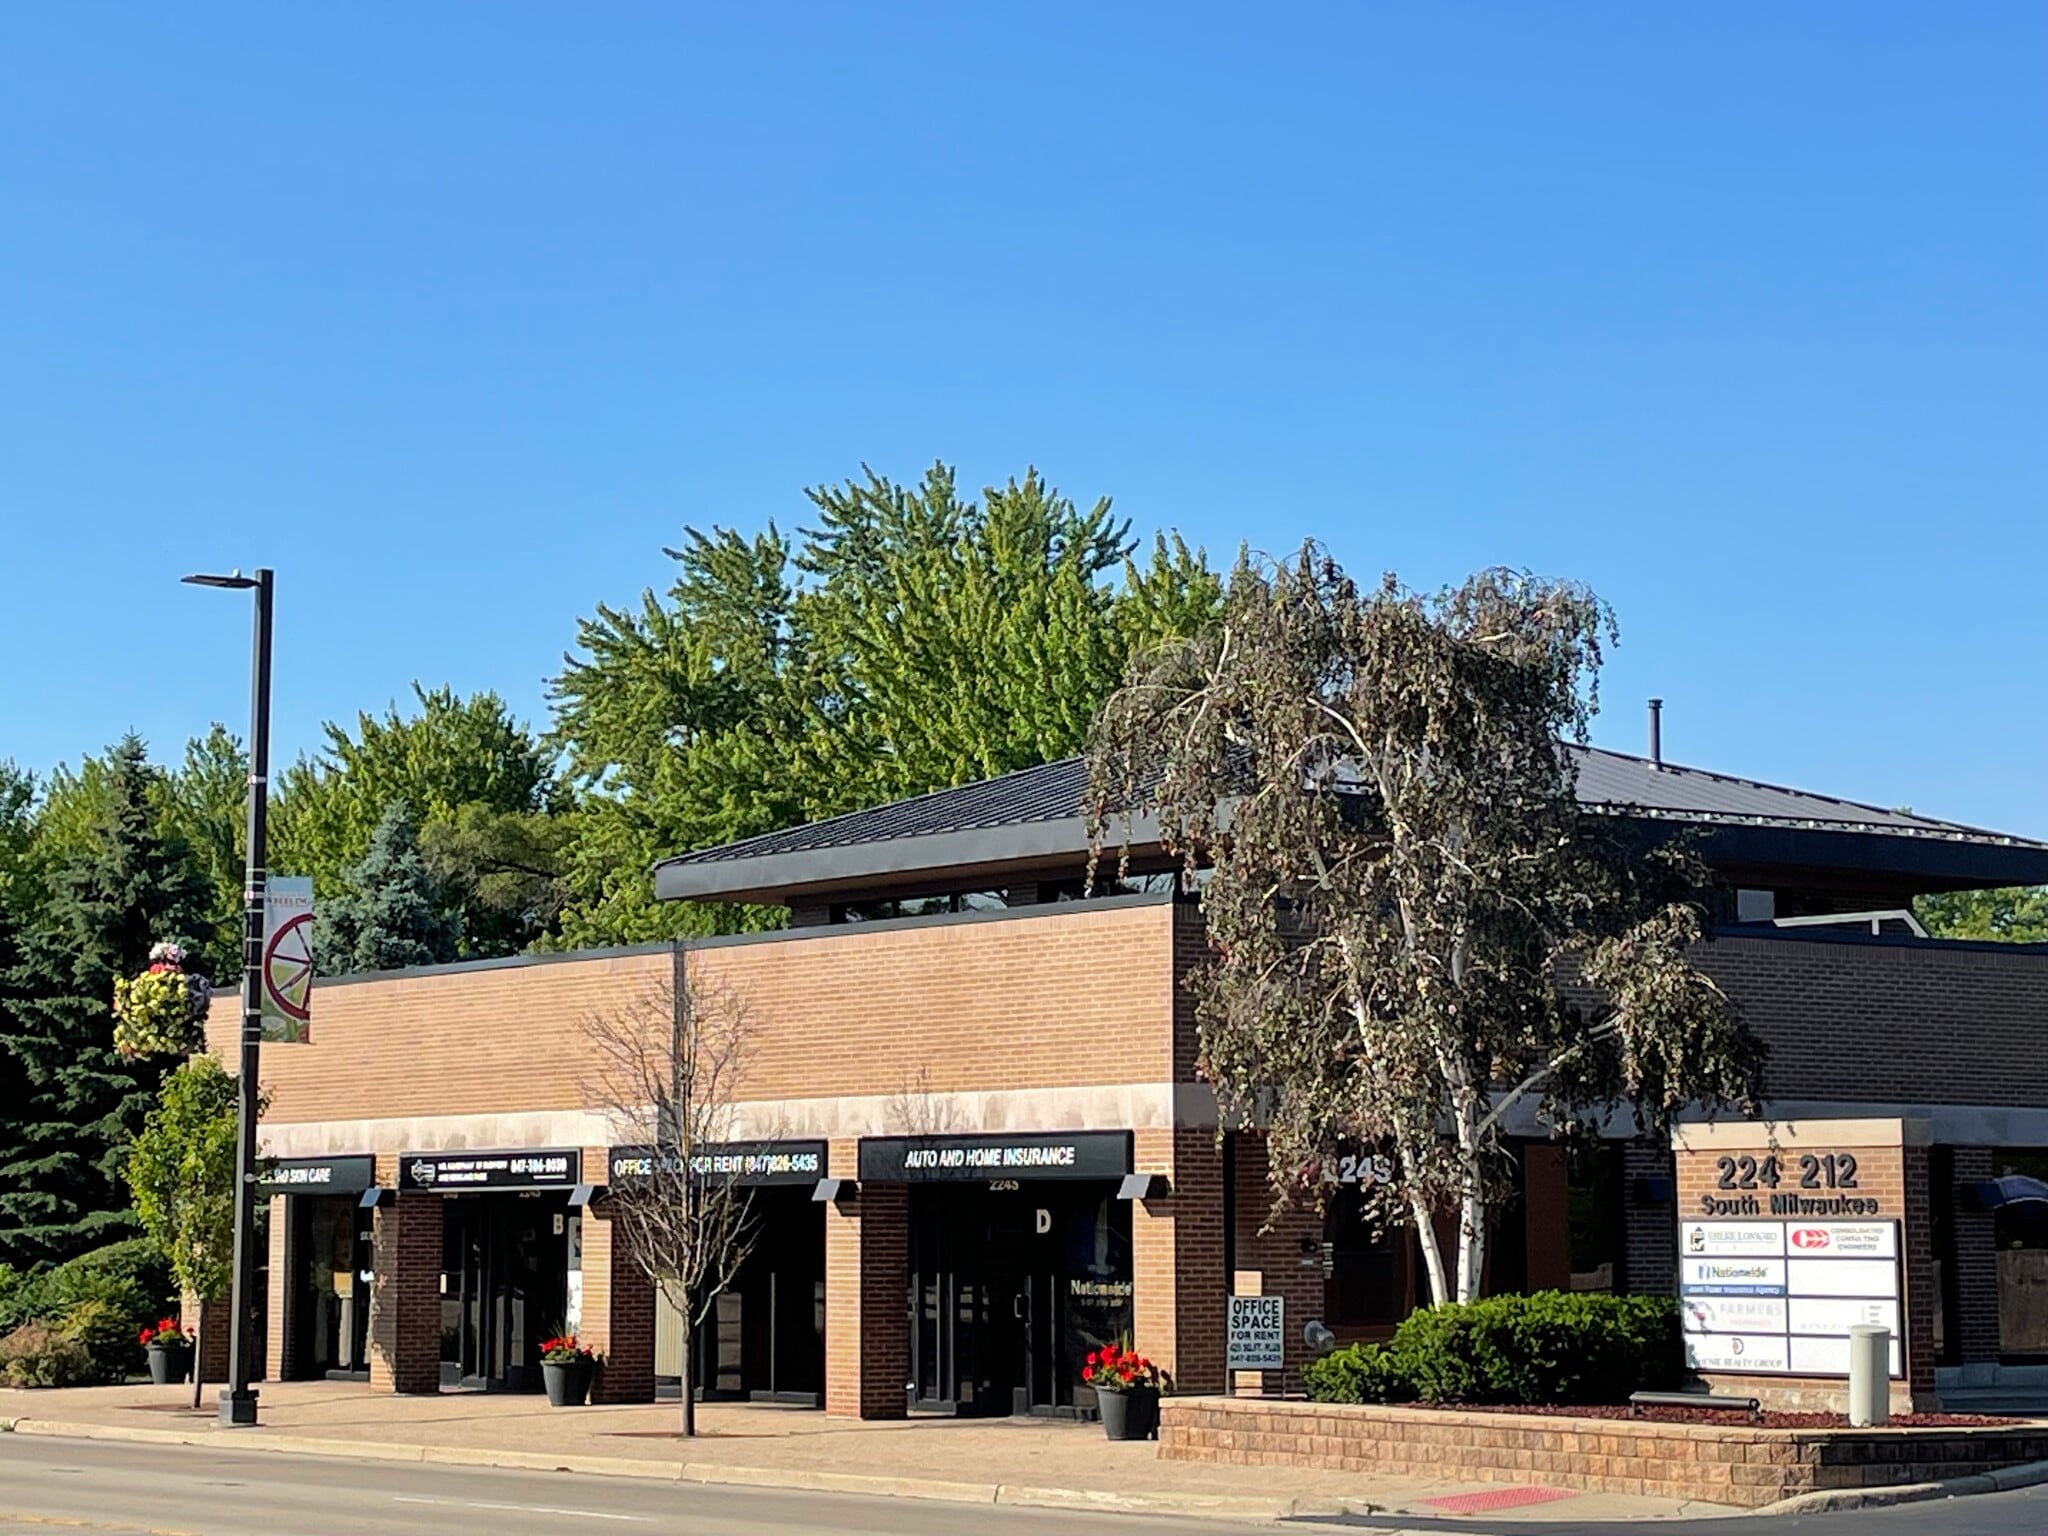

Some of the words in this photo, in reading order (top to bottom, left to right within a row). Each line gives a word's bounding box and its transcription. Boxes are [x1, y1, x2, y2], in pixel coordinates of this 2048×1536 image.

[713, 1154, 743, 1172] RENT
[905, 1150, 937, 1168] AUTO
[939, 1149, 963, 1167] AND
[965, 1148, 1000, 1166] HOME
[1002, 1147, 1075, 1165] INSURANCE
[308, 1167, 331, 1183] CARE
[614, 1158, 652, 1177] OFFICE
[1717, 1154, 1781, 1189] 224
[1800, 1154, 1858, 1189] 212
[1701, 1194, 1760, 1216] South
[1770, 1193, 1879, 1215] Milwaukee
[553, 1213, 564, 1235] B
[1036, 1209, 1052, 1233] D
[1712, 1266, 1768, 1277] Nationwide
[1070, 1279, 1133, 1297] Nationwide
[1233, 1299, 1280, 1315] OFFICE
[1720, 1303, 1783, 1316] FARMERS
[1231, 1315, 1281, 1329] SPACE
[1231, 1331, 1251, 1340] FOR
[1254, 1331, 1280, 1340] RENT
